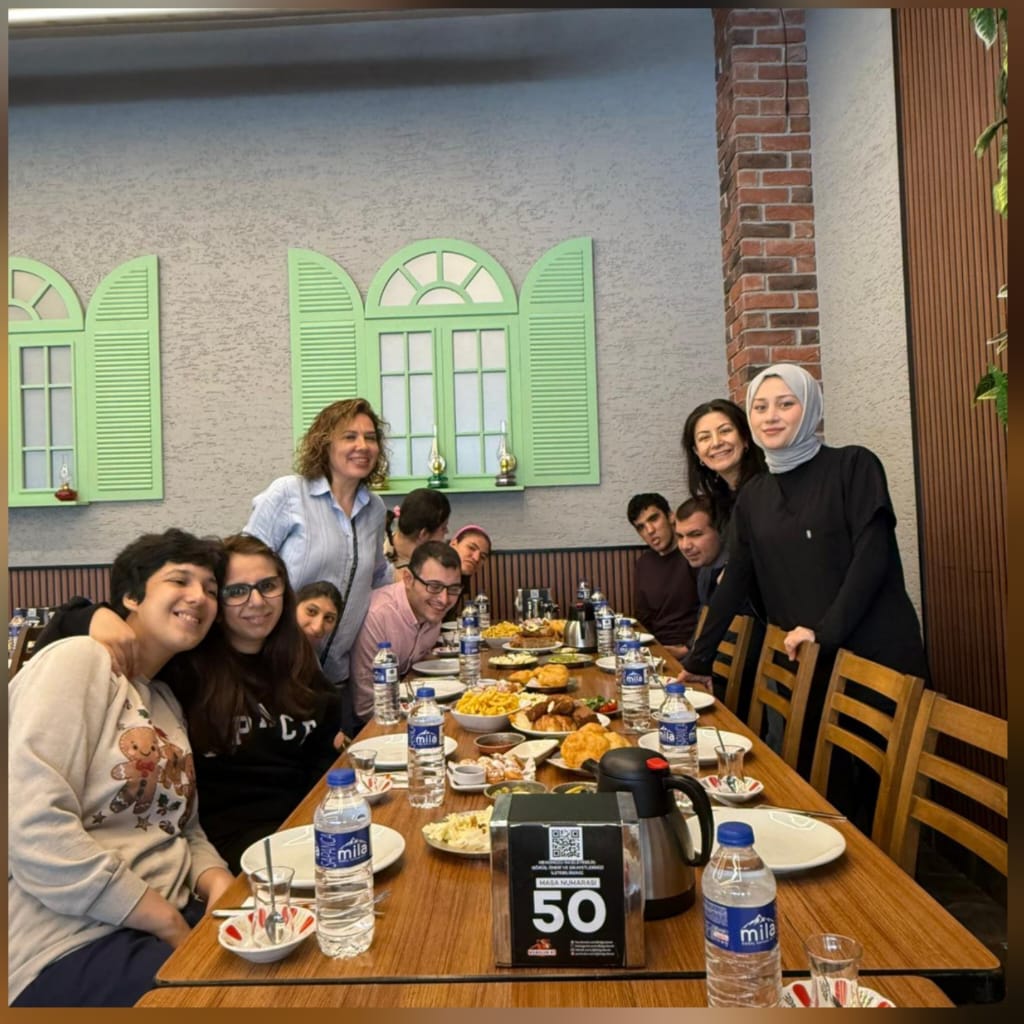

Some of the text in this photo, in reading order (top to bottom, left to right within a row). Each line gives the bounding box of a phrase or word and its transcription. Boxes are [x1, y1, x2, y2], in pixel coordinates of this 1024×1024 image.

[416, 734, 438, 745] mila
[338, 843, 368, 860] mila
[532, 889, 607, 933] 50
[740, 922, 776, 943] mila
